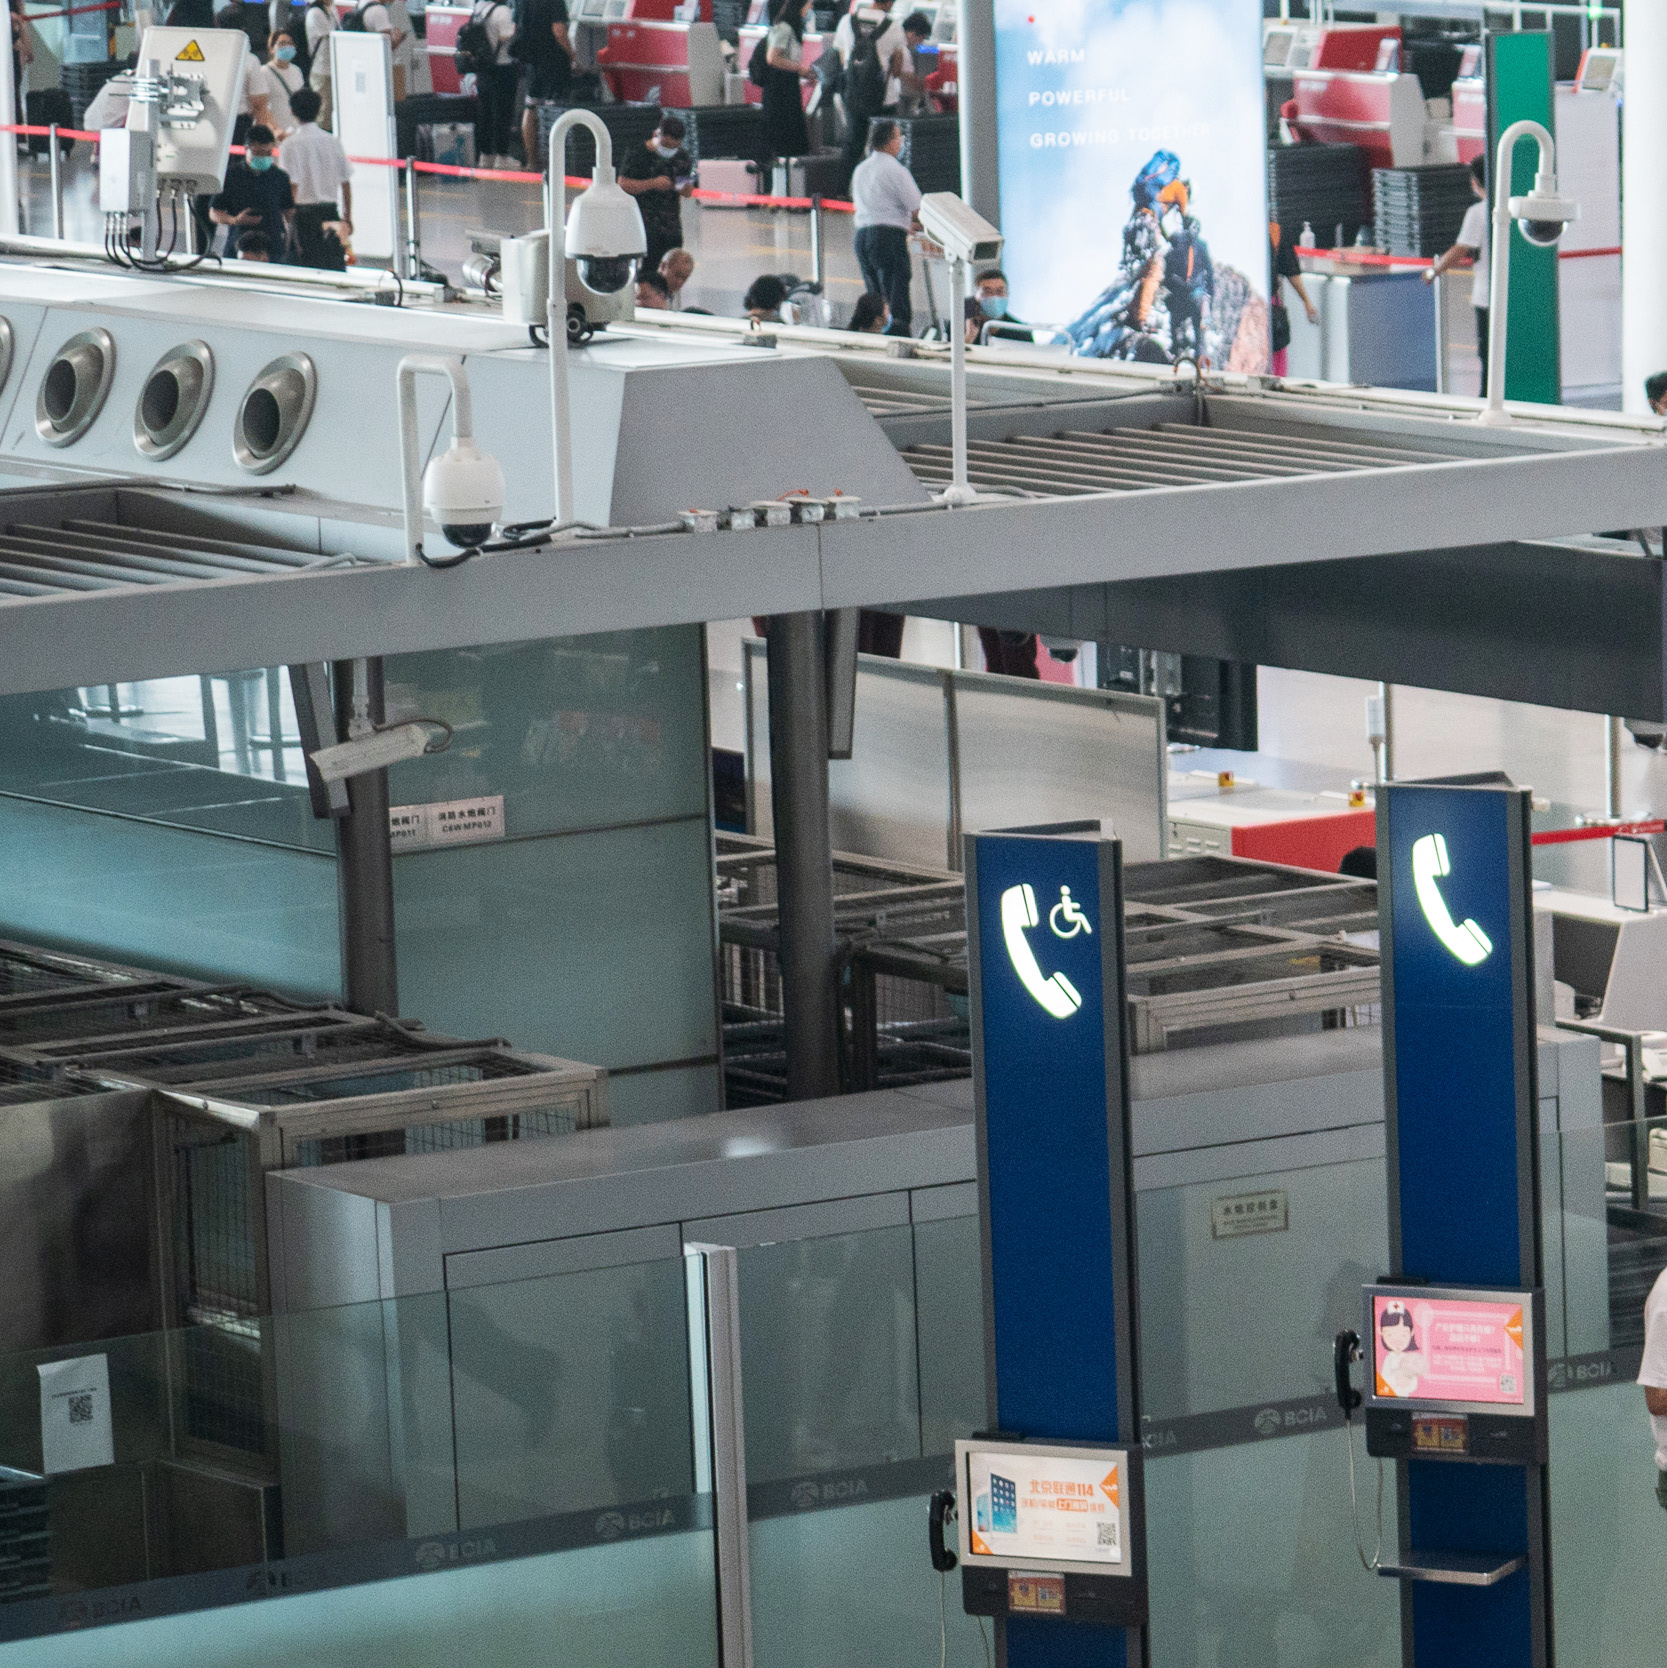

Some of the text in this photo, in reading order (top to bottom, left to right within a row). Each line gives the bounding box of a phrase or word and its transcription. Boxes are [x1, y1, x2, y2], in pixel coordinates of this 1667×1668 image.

[1027, 49, 1086, 66] WARM
[1028, 88, 1132, 107] POWERFUL
[1029, 122, 1211, 149] GROWING TOGETHER
[1284, 1406, 1328, 1428] BCIA
[822, 1479, 869, 1500] BCIA
[628, 1509, 676, 1530] BCIA
